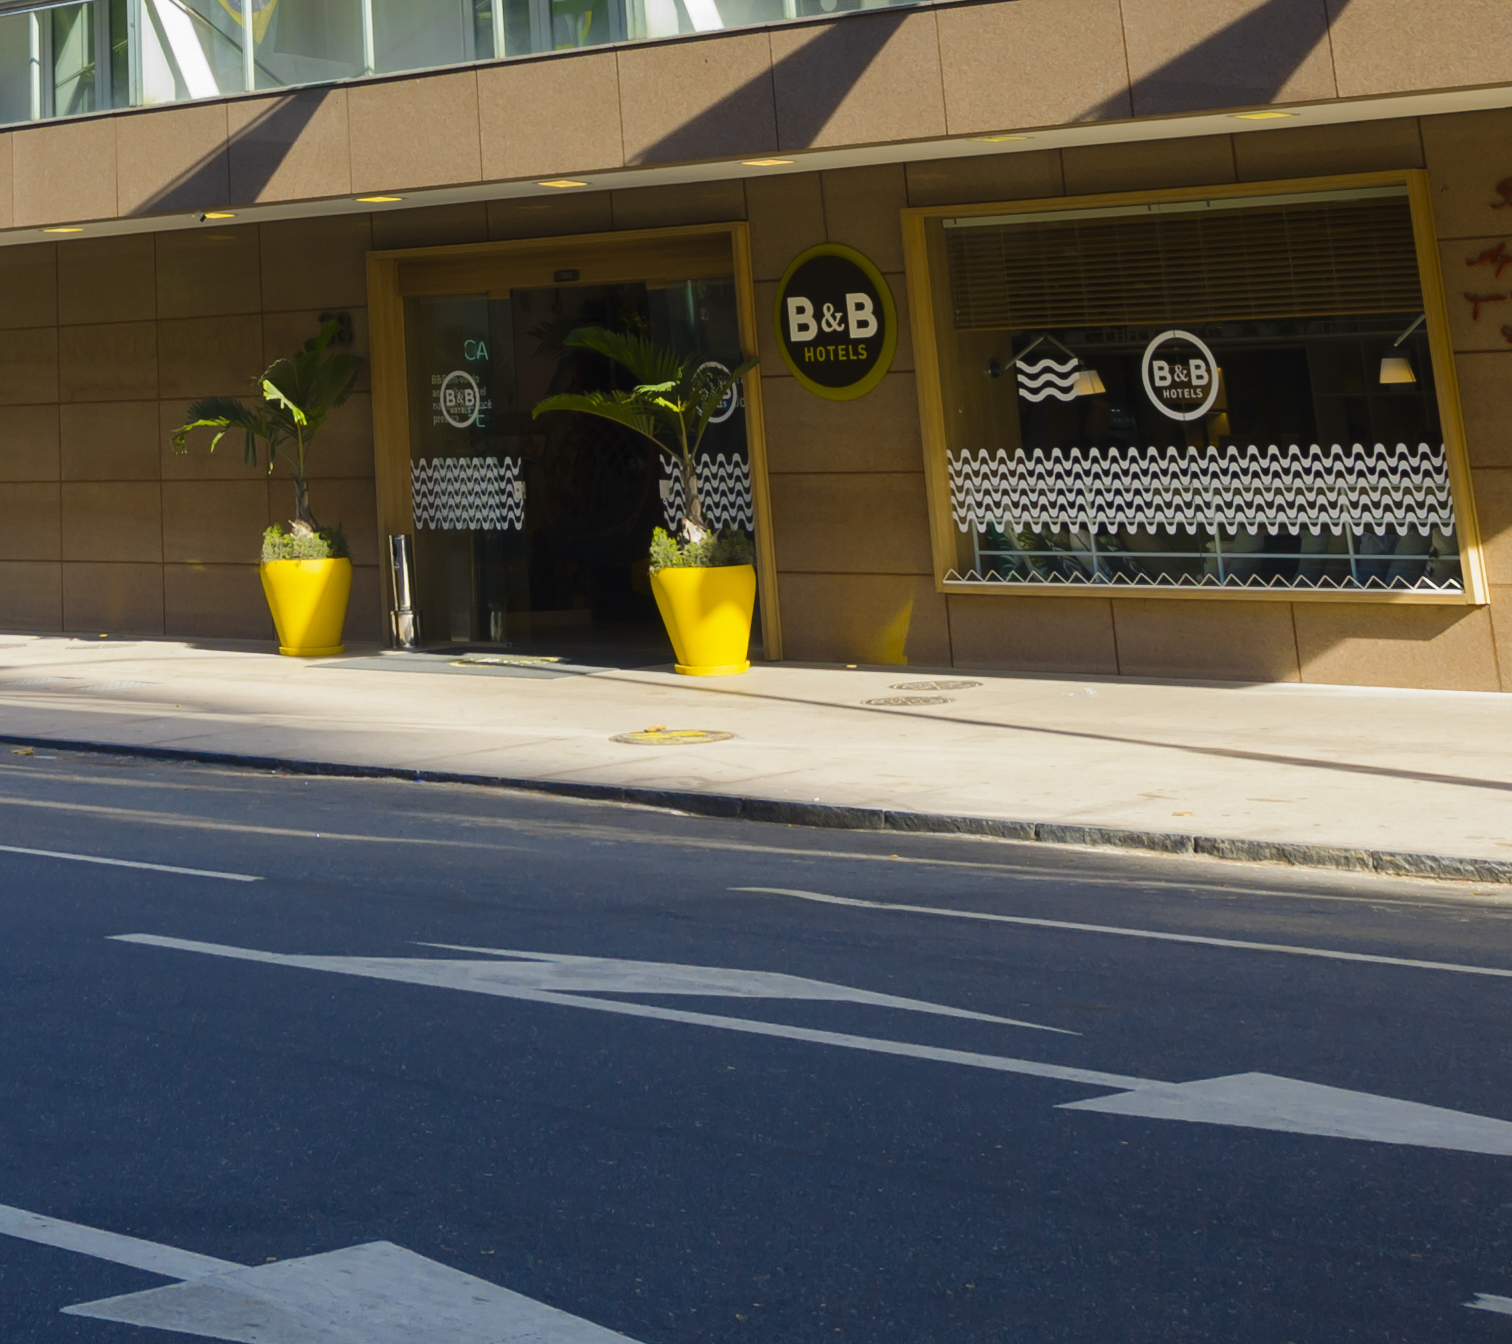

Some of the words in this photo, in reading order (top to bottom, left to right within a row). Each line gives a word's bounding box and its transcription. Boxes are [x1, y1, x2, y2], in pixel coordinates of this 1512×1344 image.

[787, 292, 878, 342] B&B
[804, 344, 867, 362] HOTELS
[1152, 359, 1209, 387] B&B
[445, 388, 475, 407] B&B
[1162, 388, 1203, 399] HOTELS
